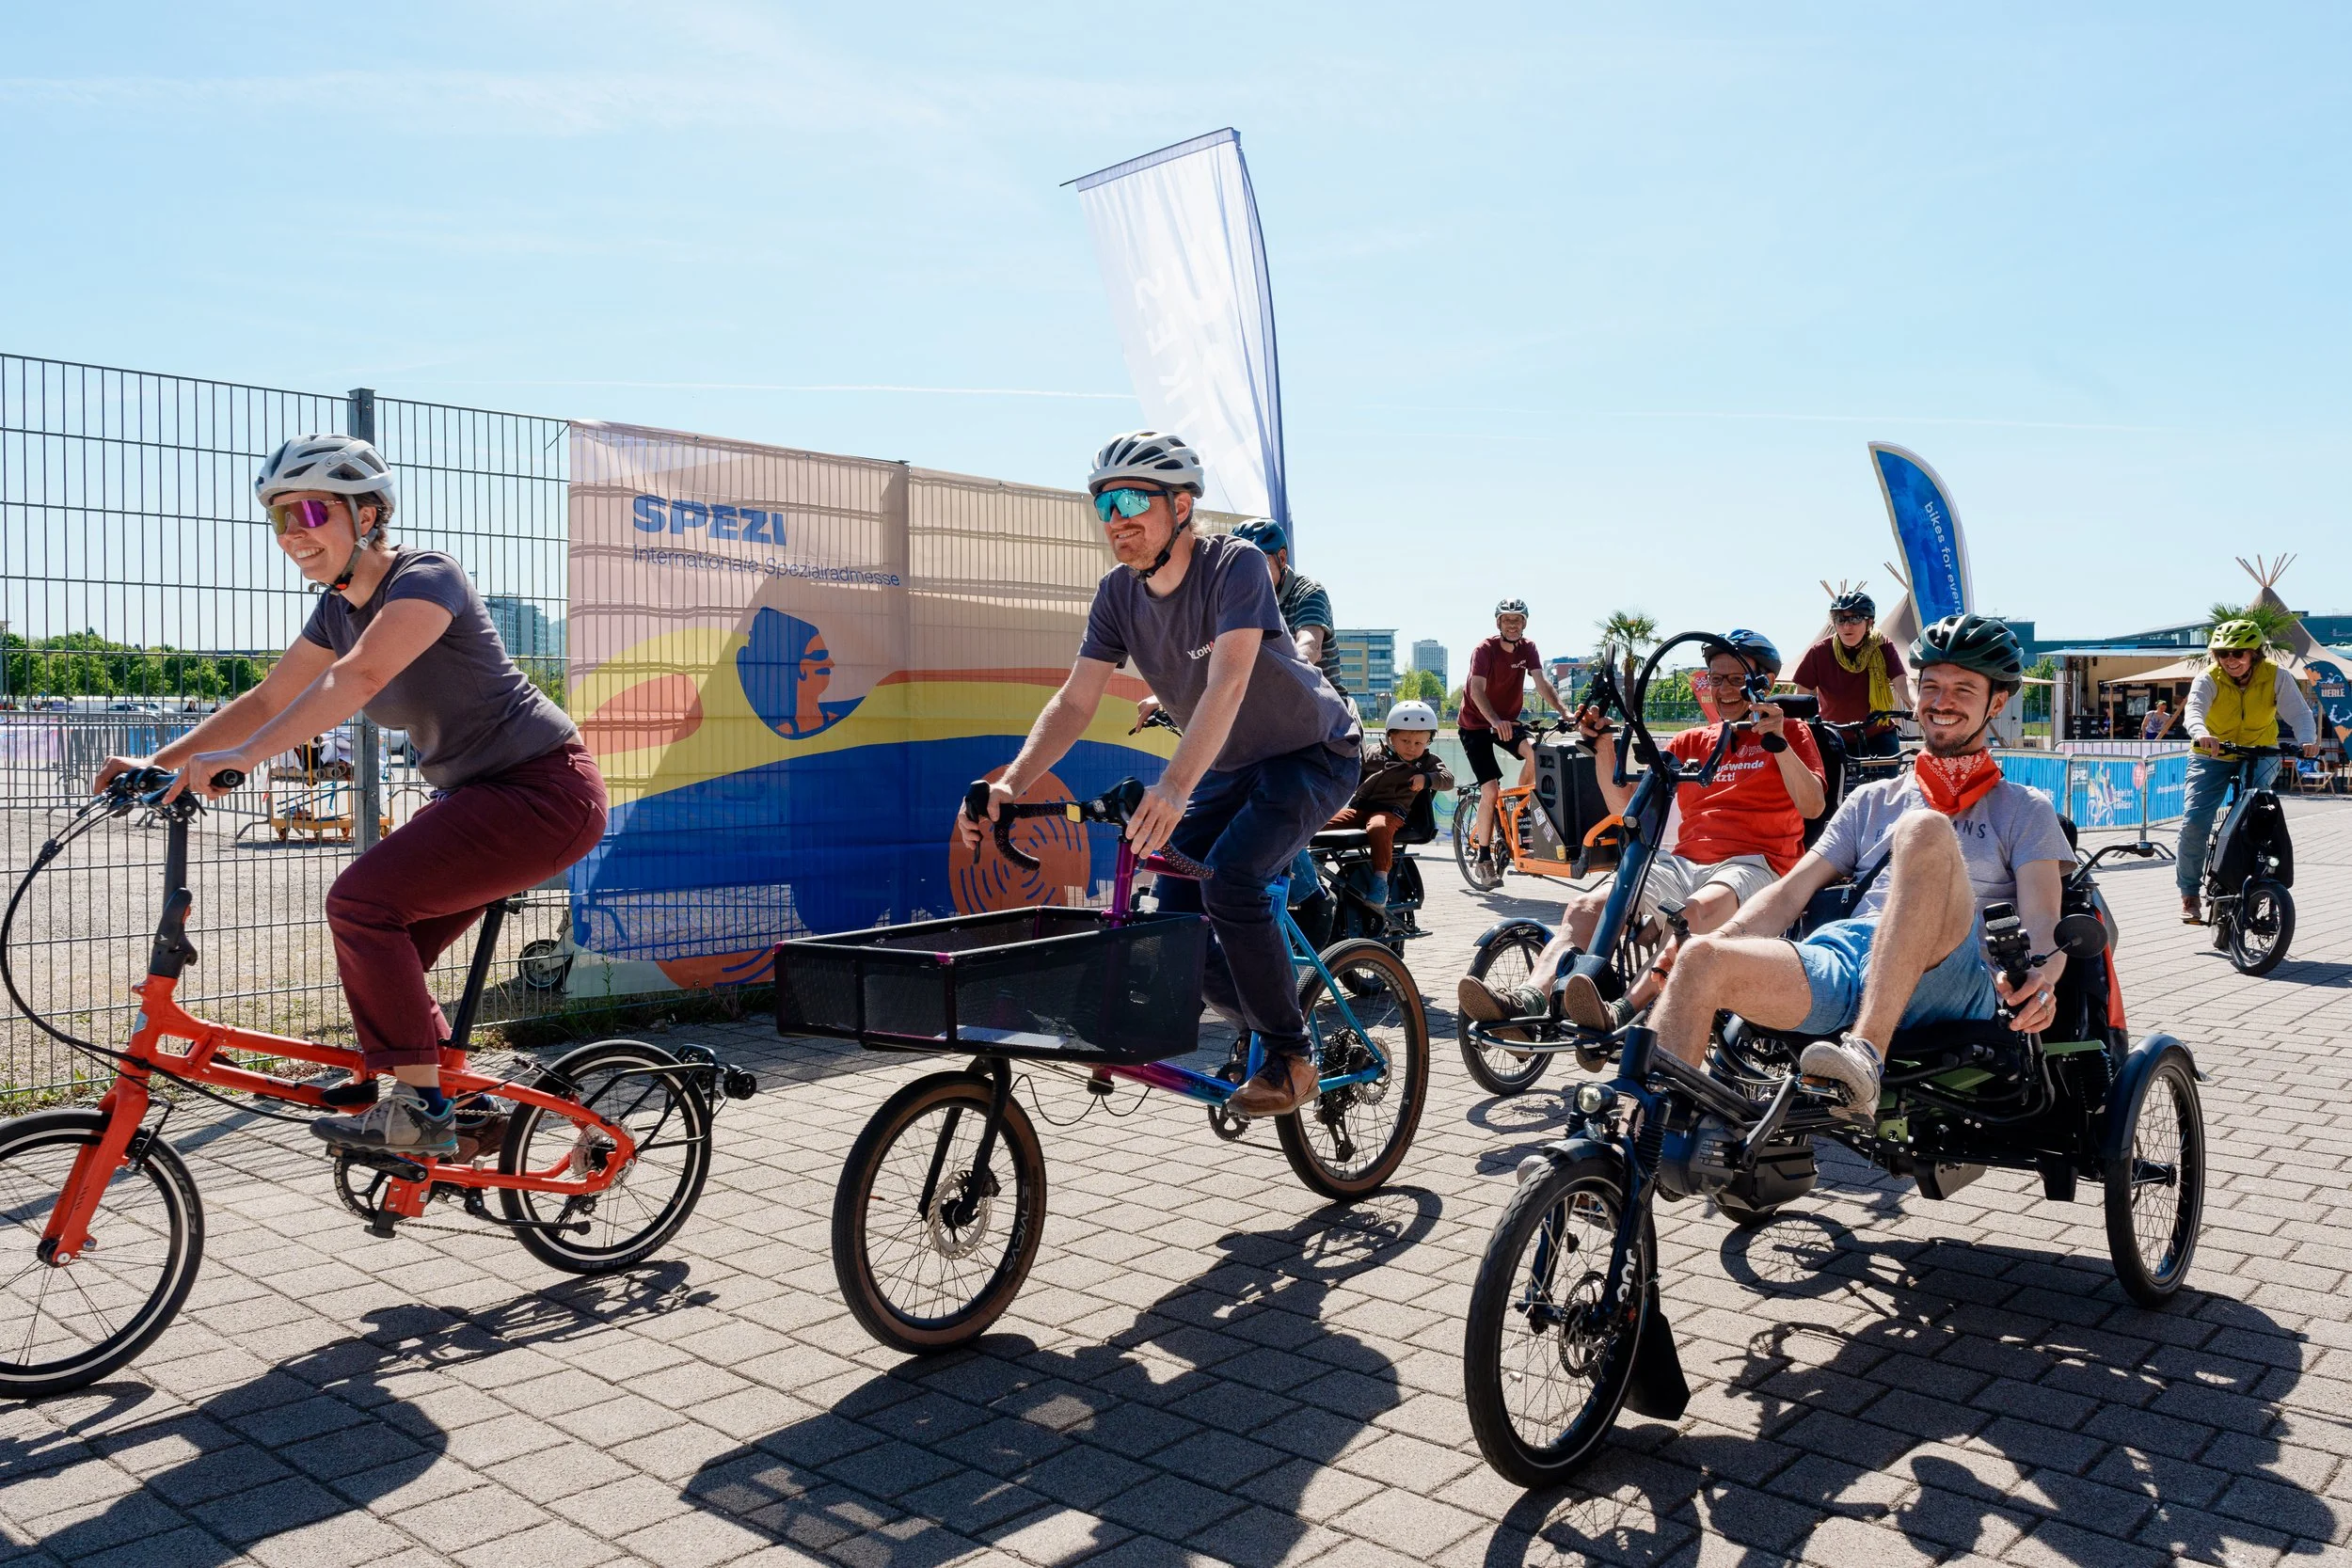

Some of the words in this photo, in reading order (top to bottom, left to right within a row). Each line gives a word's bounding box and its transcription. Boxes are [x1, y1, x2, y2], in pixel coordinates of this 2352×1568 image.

[633, 494, 787, 546] SPEZI
[1924, 501, 1945, 543] bikes
[1942, 546, 1952, 569] for
[633, 545, 758, 573] Internationale
[764, 557, 900, 586] Spezialradmesse
[579, 1224, 678, 1269] SCHWALBE
